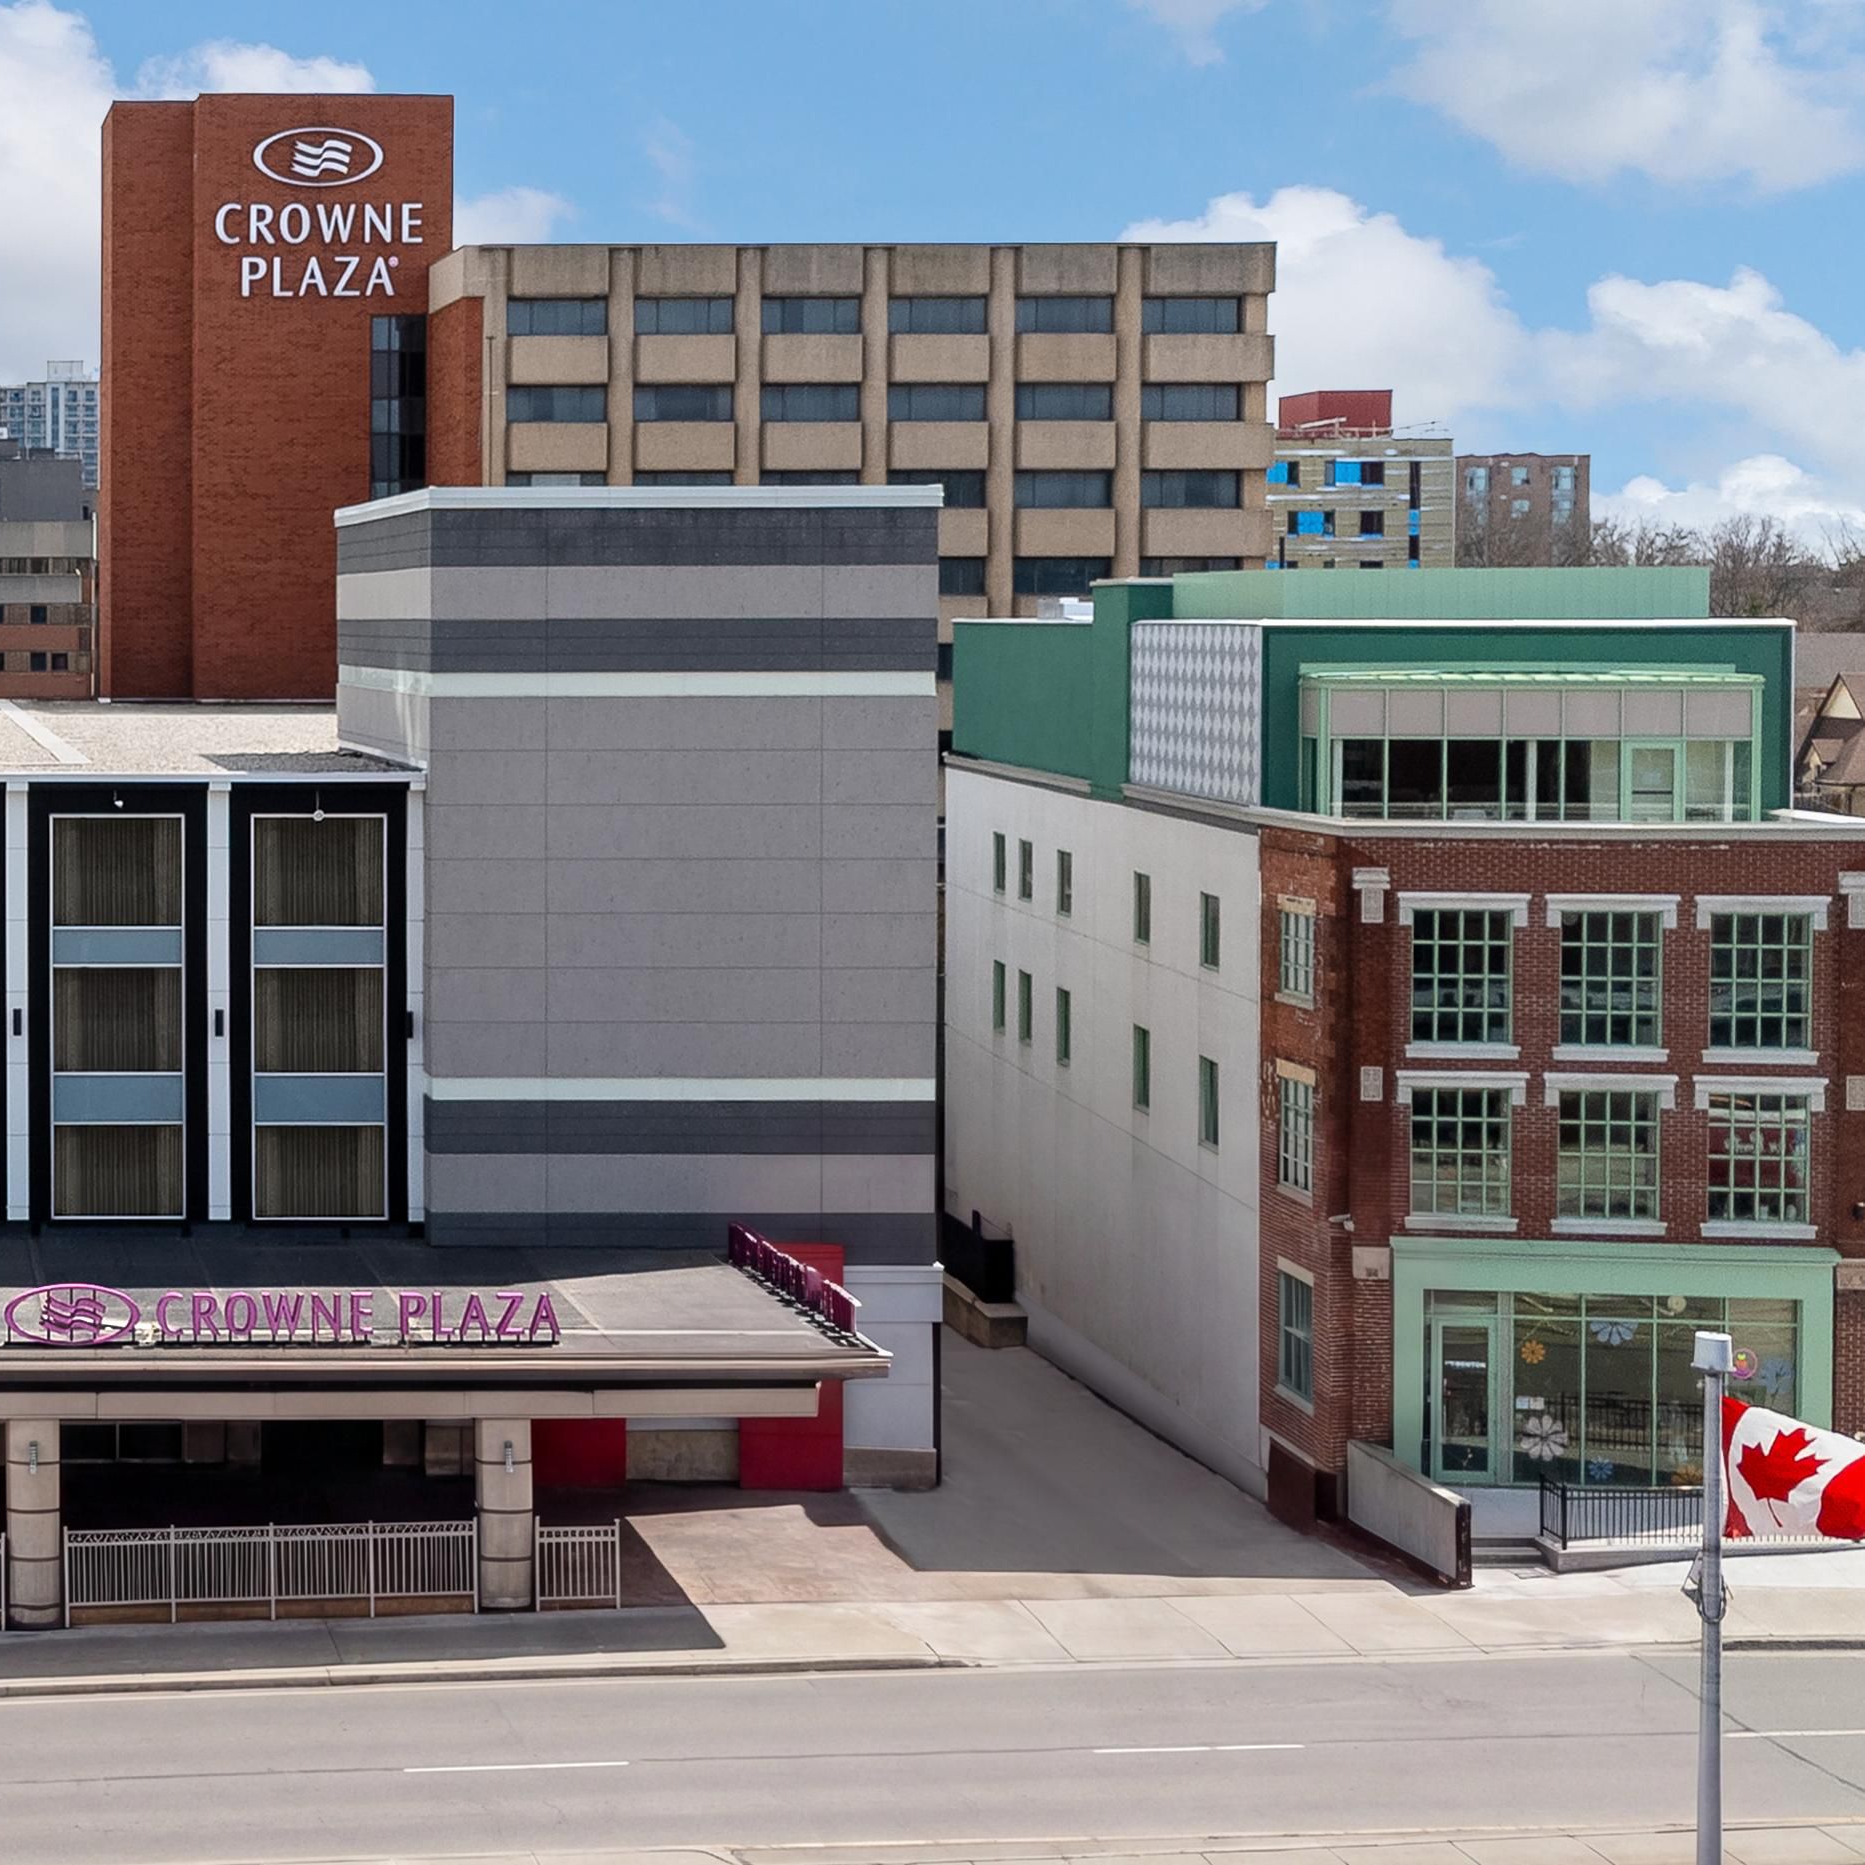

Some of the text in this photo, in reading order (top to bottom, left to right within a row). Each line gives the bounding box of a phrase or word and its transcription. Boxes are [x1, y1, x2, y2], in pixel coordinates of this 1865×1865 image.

[215, 203, 423, 244] CROWNE
[156, 1291, 561, 1337] CROWNE PLAZA
